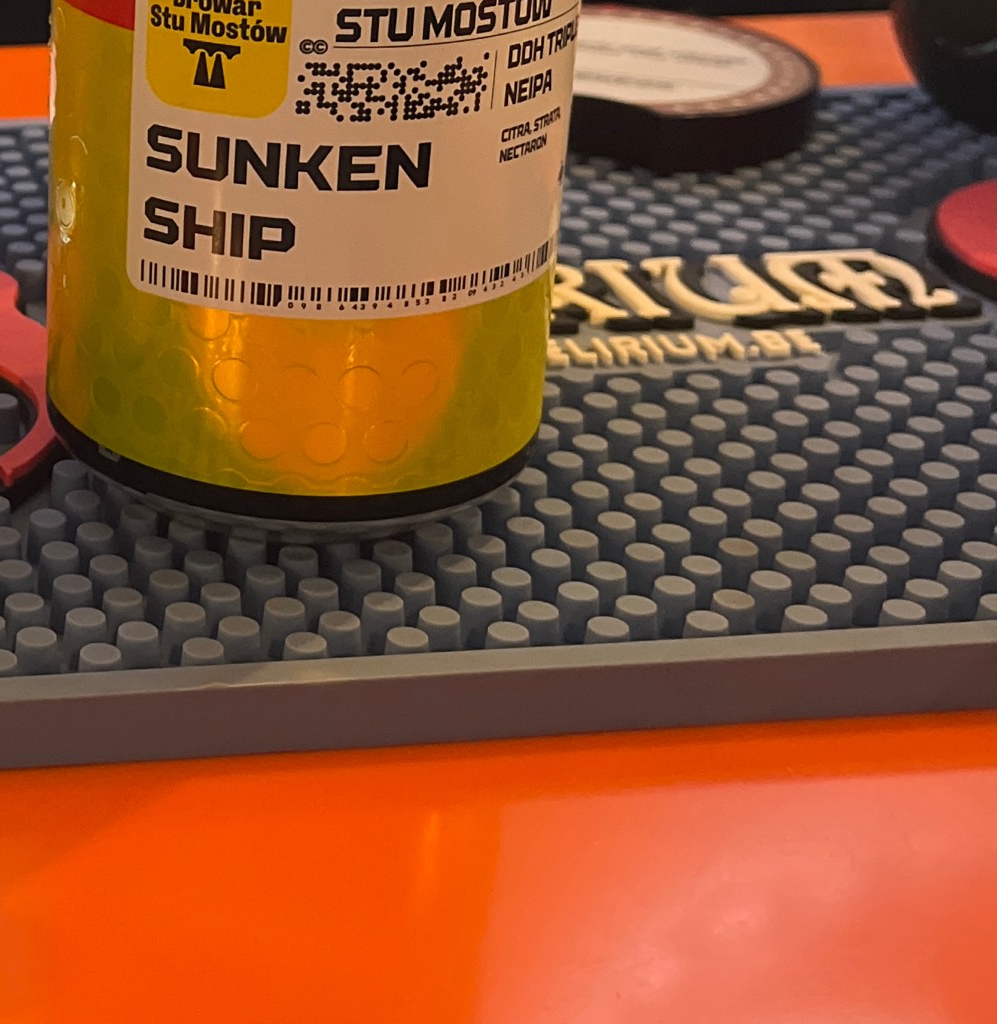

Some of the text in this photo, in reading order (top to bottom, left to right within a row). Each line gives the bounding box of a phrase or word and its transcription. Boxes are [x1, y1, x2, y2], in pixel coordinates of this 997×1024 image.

[150, 4, 288, 44] Stu Mostów
[335, 7, 415, 43] STU
[507, 35, 545, 69] DDH
[503, 69, 553, 107] NEIPA
[146, 124, 432, 192] SUNKEN
[499, 133, 547, 163] NECTARON
[143, 196, 296, 261] SHIP
